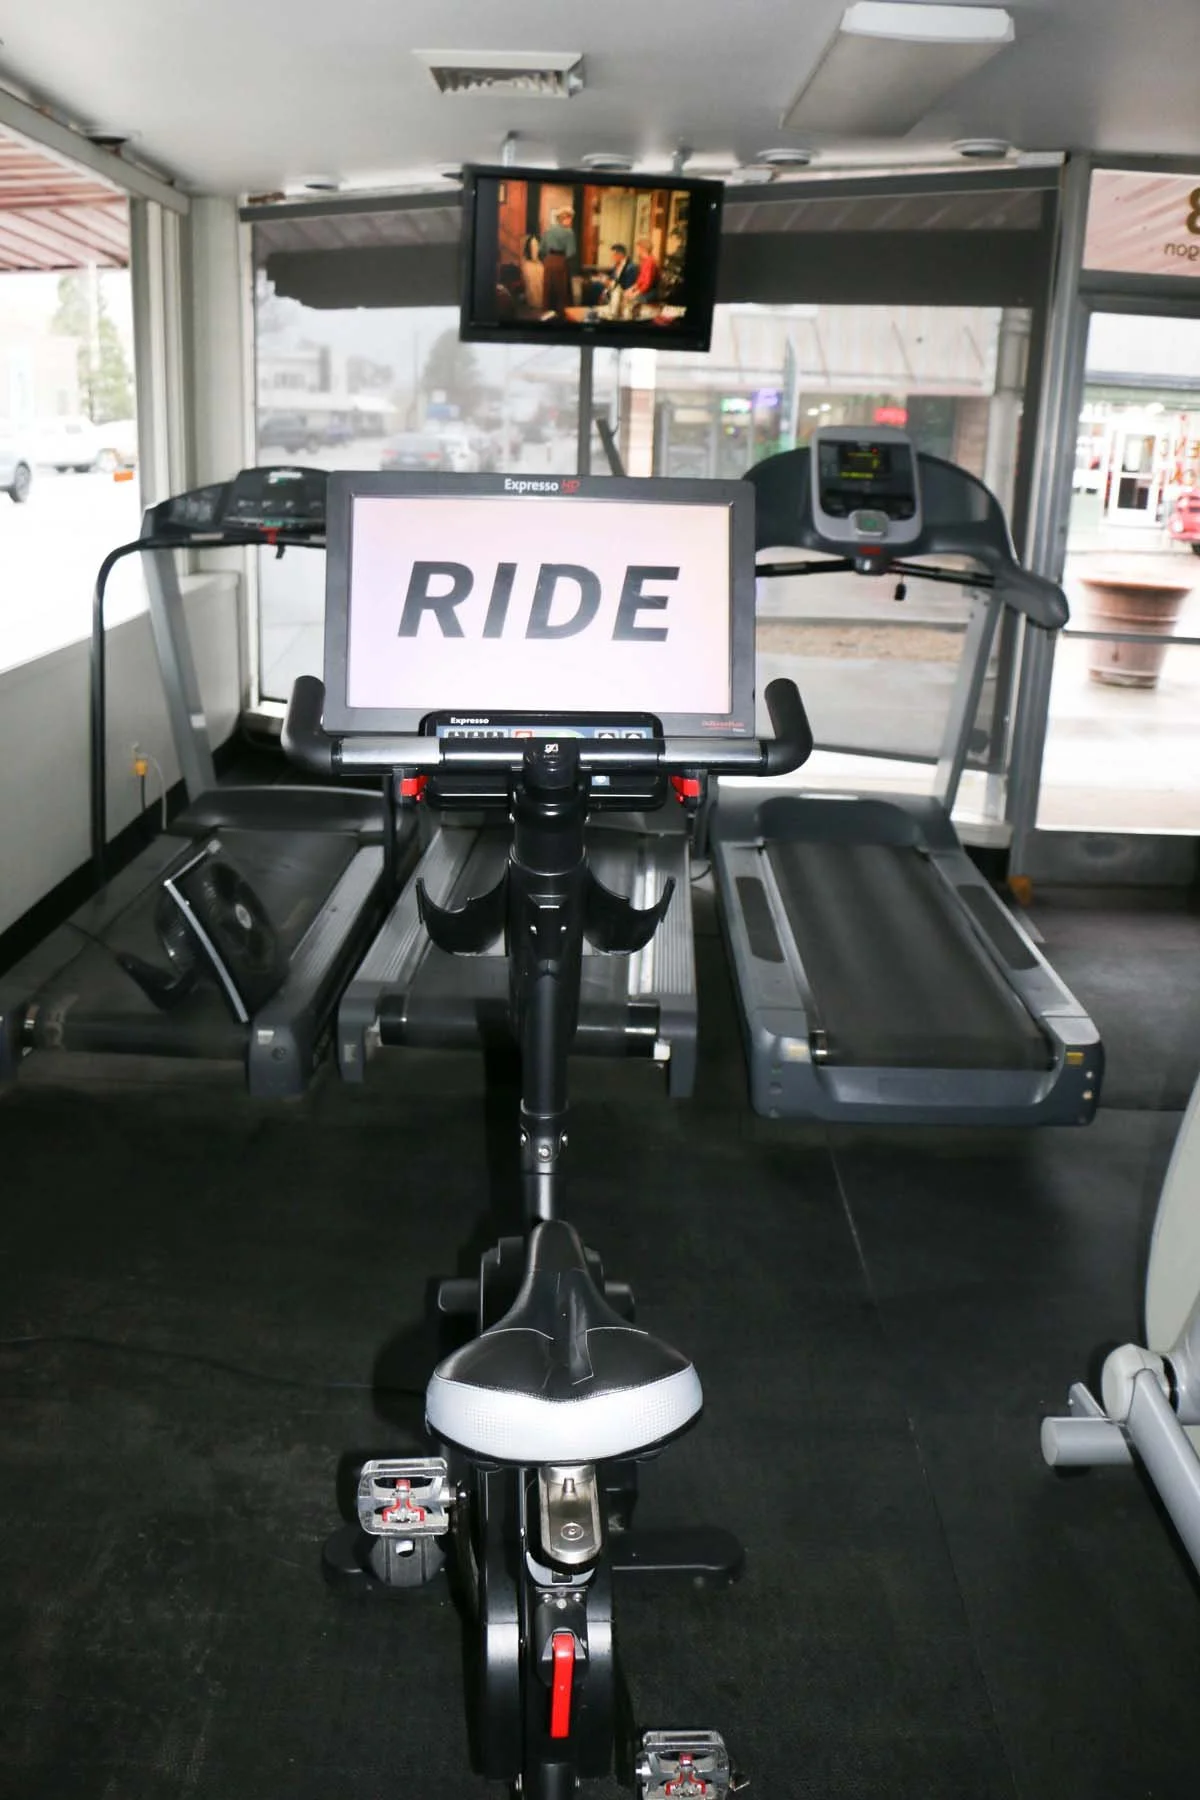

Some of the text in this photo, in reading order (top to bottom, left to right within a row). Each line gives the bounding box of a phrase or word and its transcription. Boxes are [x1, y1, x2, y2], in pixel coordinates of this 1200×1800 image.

[504, 478, 559, 493] Expresso
[398, 560, 680, 642] RIDE
[450, 716, 489, 725] Expresso
